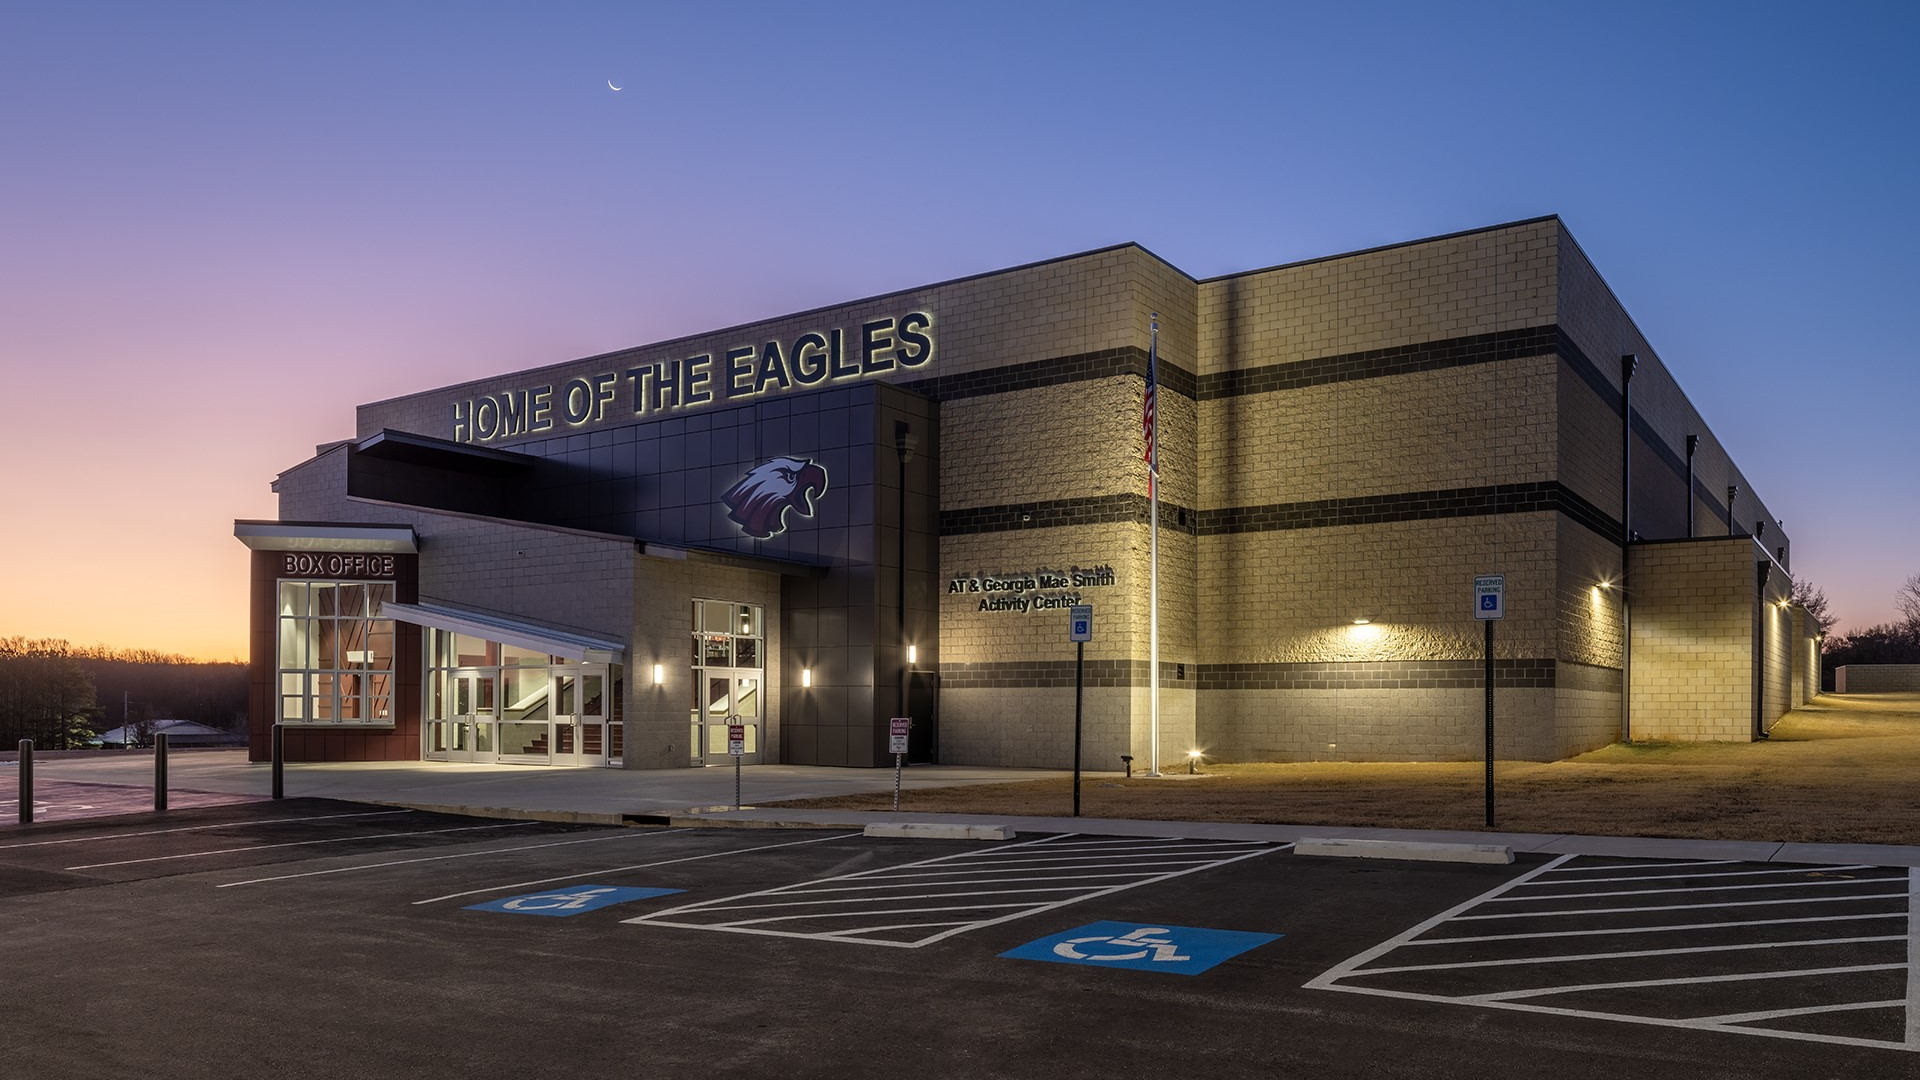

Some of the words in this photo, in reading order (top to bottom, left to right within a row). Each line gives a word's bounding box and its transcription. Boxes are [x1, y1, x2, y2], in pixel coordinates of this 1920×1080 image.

[453, 385, 552, 443] HOME
[562, 370, 615, 425] OF
[626, 354, 713, 414] THE
[726, 310, 935, 399] EAGLES
[283, 553, 324, 575] BOX
[327, 554, 395, 576] OFFICE
[948, 580, 967, 594] AT
[968, 579, 980, 593] &
[982, 576, 1036, 594] Georgia
[1039, 576, 1069, 590] Mae
[1072, 573, 1116, 588] Smith
[1475, 578, 1503, 586] RESERVED
[1477, 586, 1500, 594] PARKING
[978, 597, 1030, 614] Activity
[1033, 595, 1082, 609] Center
